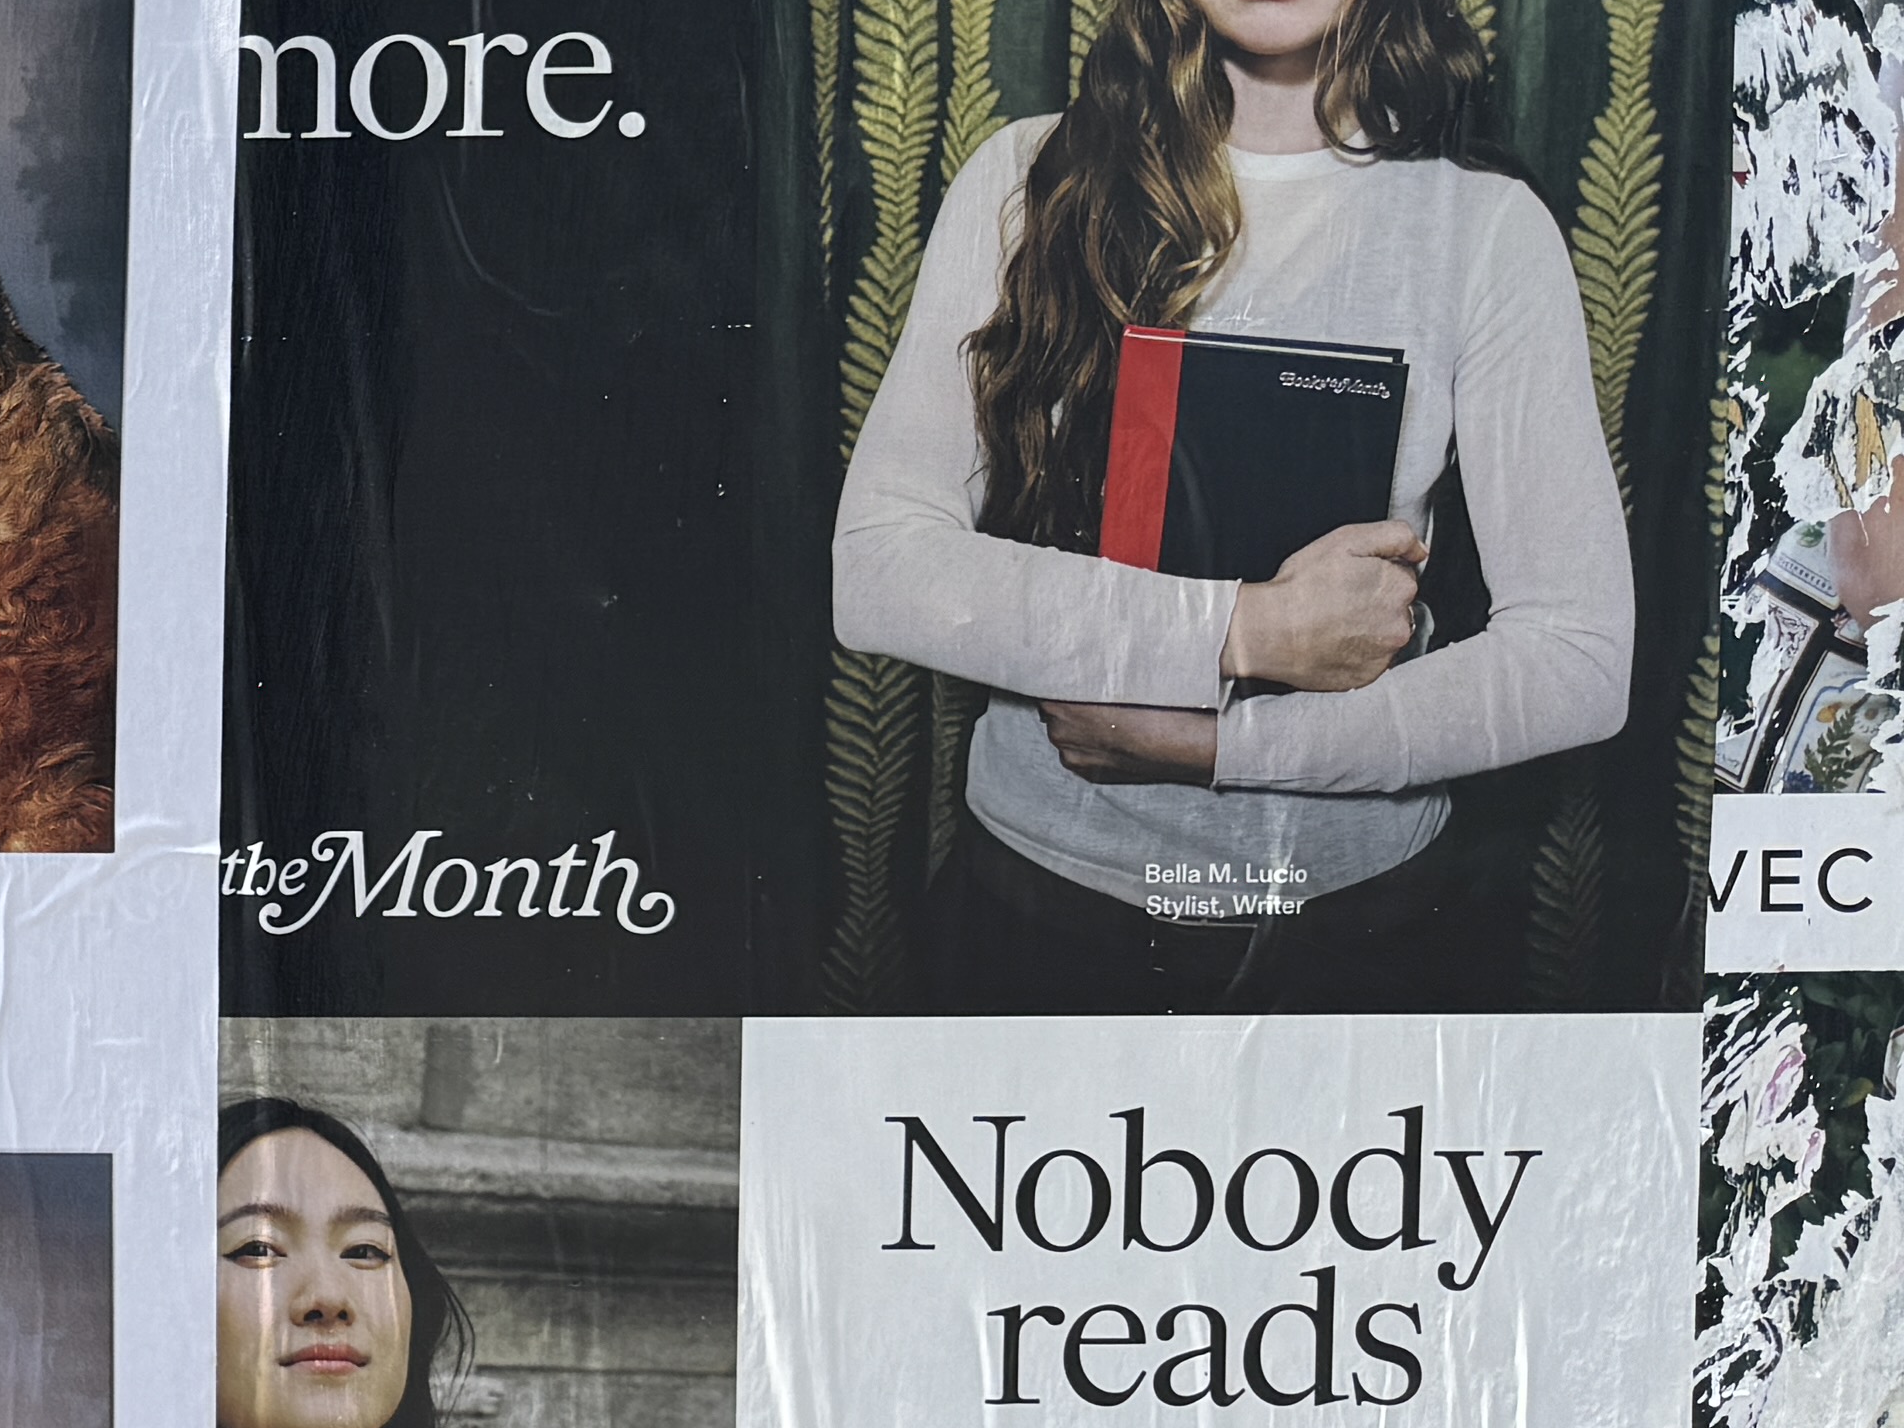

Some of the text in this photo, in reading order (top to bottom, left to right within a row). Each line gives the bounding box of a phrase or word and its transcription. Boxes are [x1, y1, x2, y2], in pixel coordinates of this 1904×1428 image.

[221, 830, 675, 936] the Month
[1145, 864, 1307, 884] Bella M. Lucio
[1146, 895, 1304, 919] Stylist, Writer
[1708, 848, 1873, 912] VEC
[881, 1104, 1543, 1291] Nobody
[984, 1264, 1423, 1408] reads
